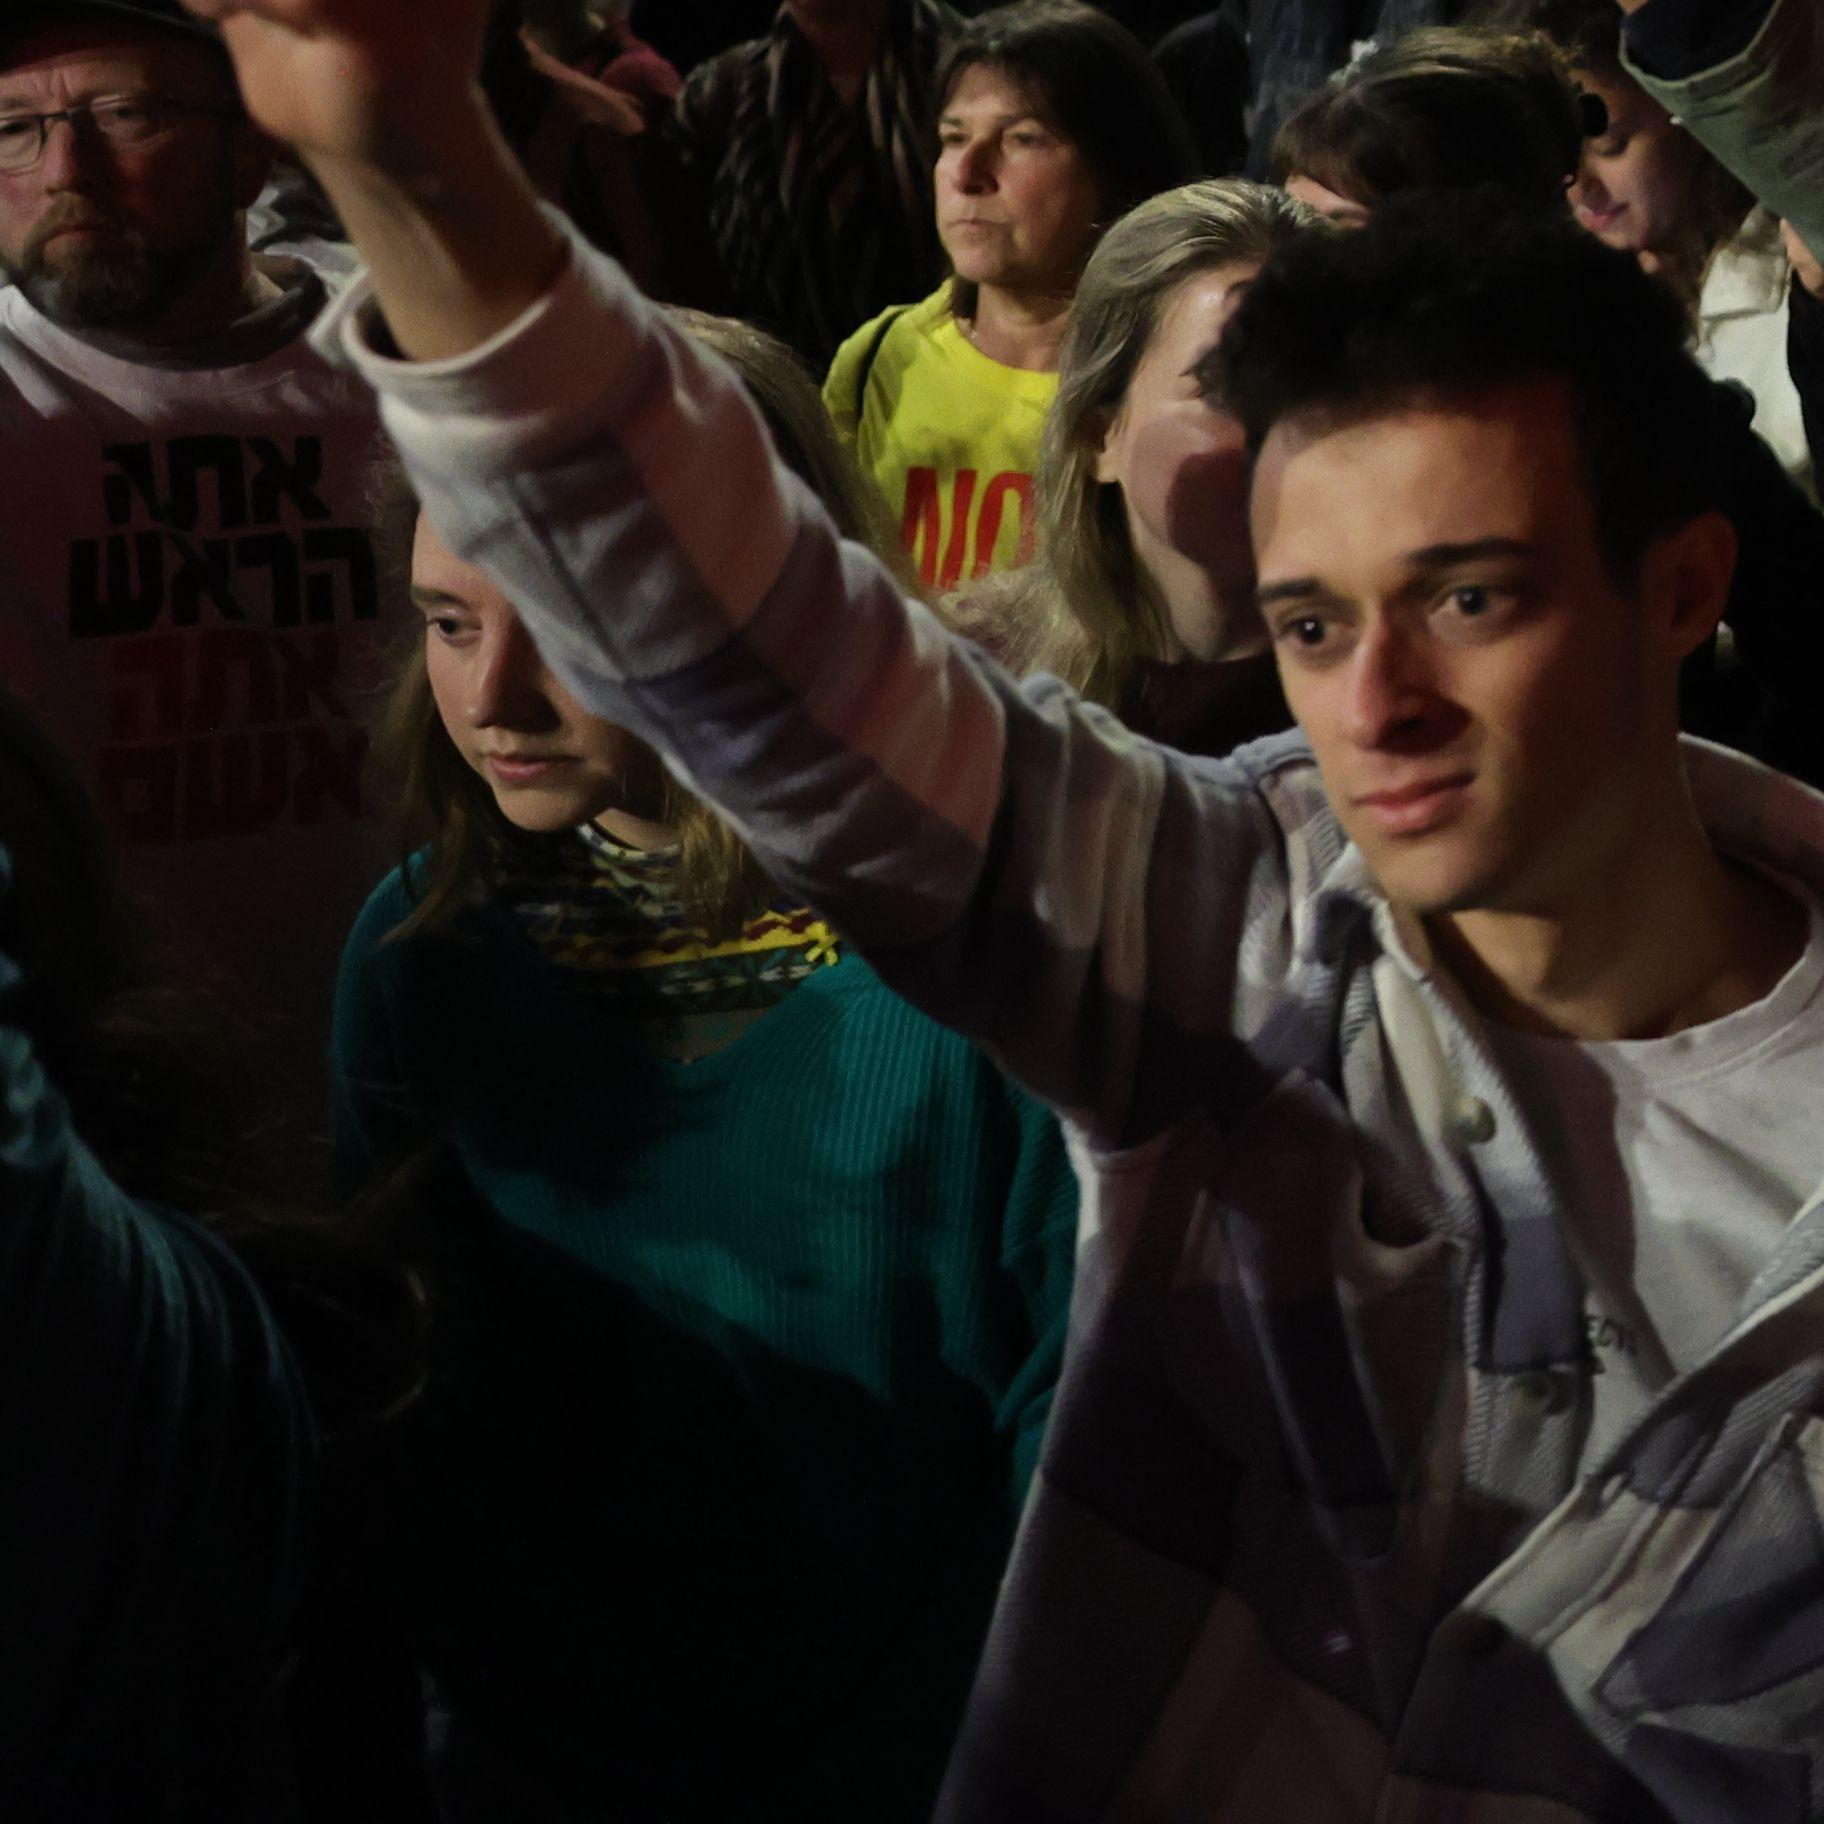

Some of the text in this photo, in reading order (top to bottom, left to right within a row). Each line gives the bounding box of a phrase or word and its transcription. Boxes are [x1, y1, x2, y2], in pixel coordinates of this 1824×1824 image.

[101, 433, 333, 532] אתה
[70, 526, 380, 639] הראש
[110, 626, 352, 739] אתה
